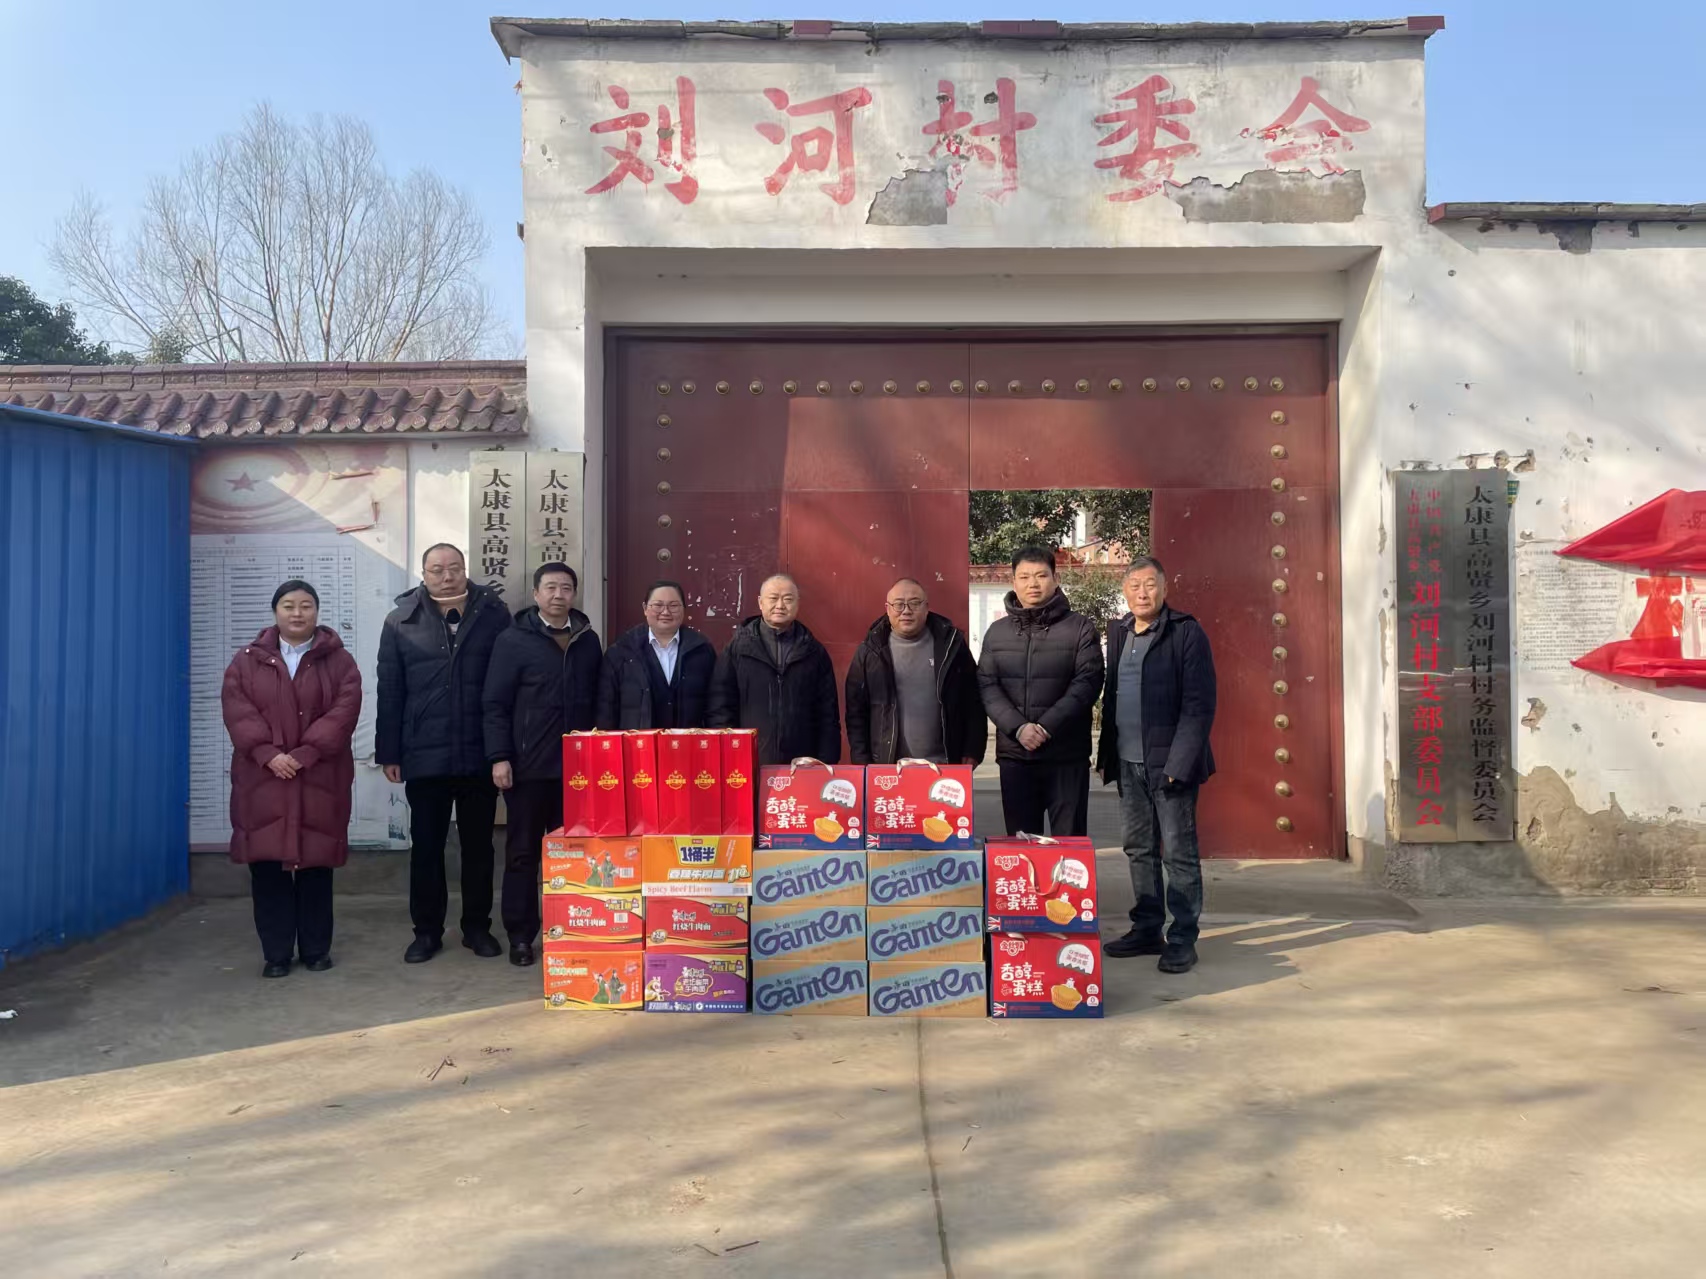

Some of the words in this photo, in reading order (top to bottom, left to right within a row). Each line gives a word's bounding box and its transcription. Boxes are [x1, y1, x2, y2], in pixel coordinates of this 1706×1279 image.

[584, 74, 1371, 206] 刘河村委会
[539, 469, 569, 563] 太康县高
[1409, 580, 1445, 826] 刘河村支部委员会
[766, 796, 797, 814] 香醇
[874, 796, 905, 814] 香醇
[777, 812, 808, 829] 蛋糕
[885, 812, 916, 829] 蛋糕
[680, 846, 715, 862] 1桶半
[995, 876, 1027, 895] 香醇
[1006, 893, 1039, 911] 蛋糕
[1000, 961, 1033, 981] 香醇
[1012, 979, 1045, 996] 蛋糕
